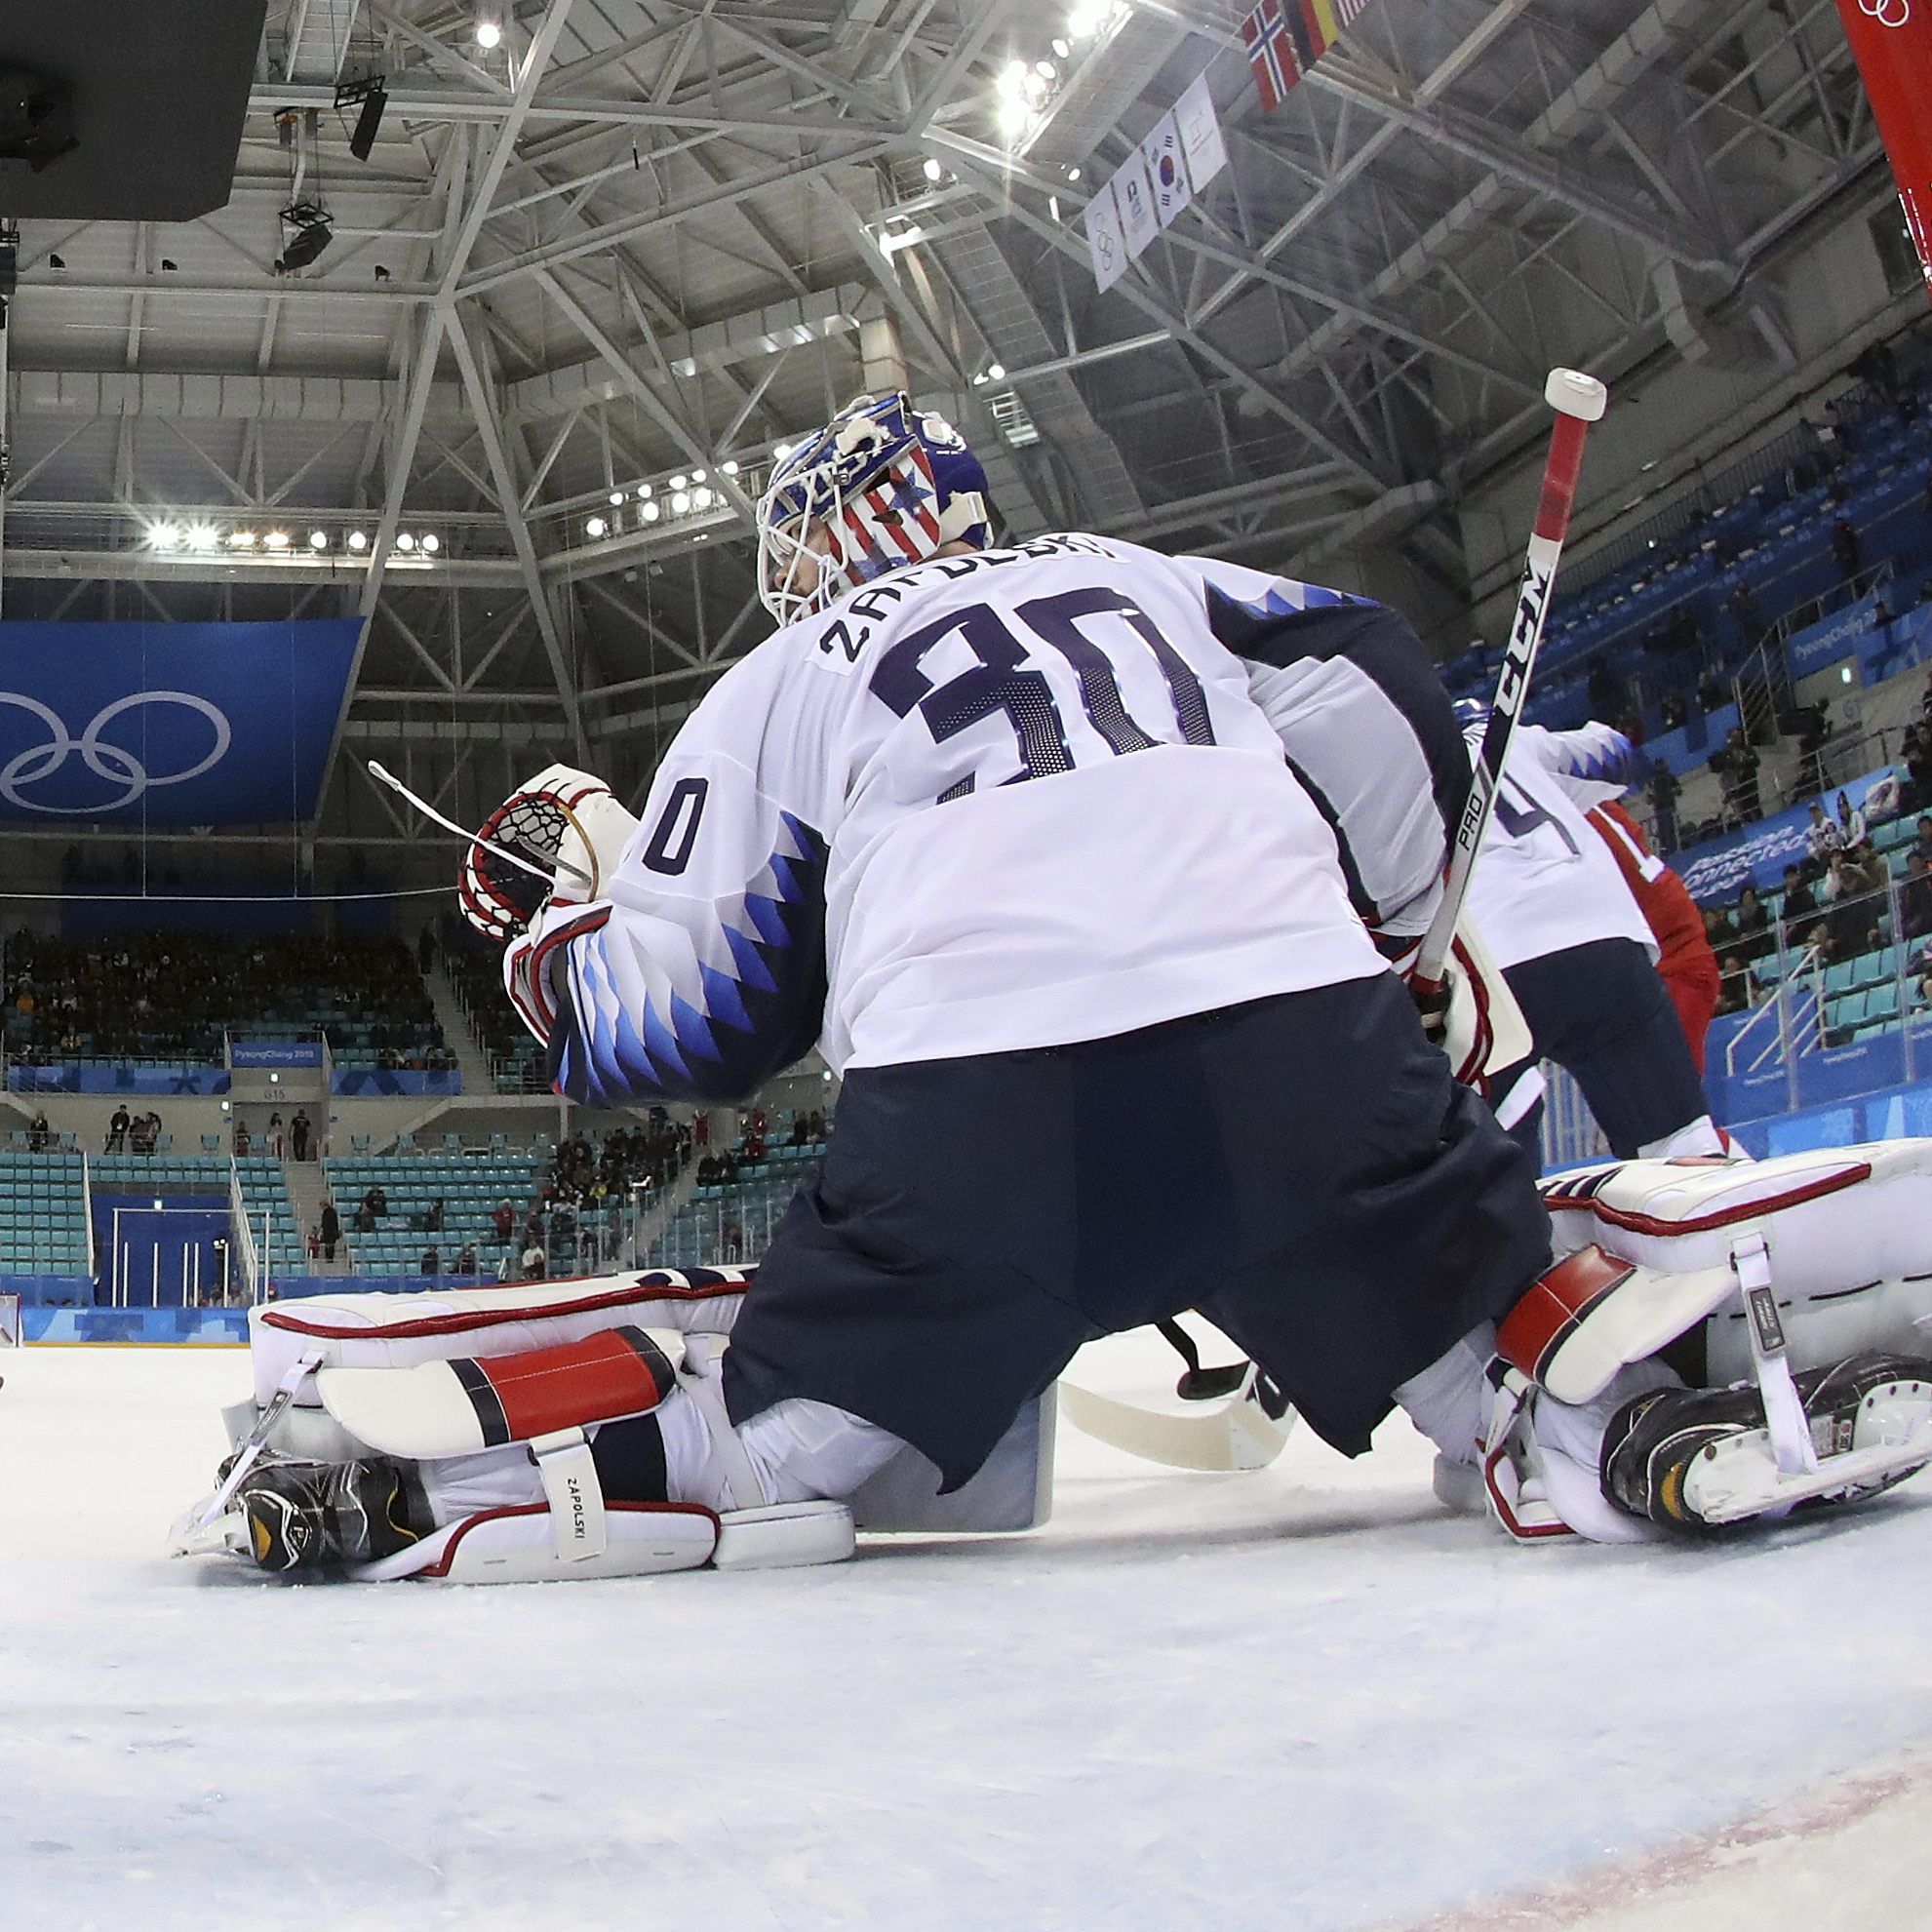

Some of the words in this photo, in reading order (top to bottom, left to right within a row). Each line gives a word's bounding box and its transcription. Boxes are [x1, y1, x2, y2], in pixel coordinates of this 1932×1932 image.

[1494, 557, 1554, 718] CCM
[642, 777, 709, 876] 0
[1458, 793, 1484, 851] PRO
[568, 1478, 585, 1539] ZAPOLSKI
